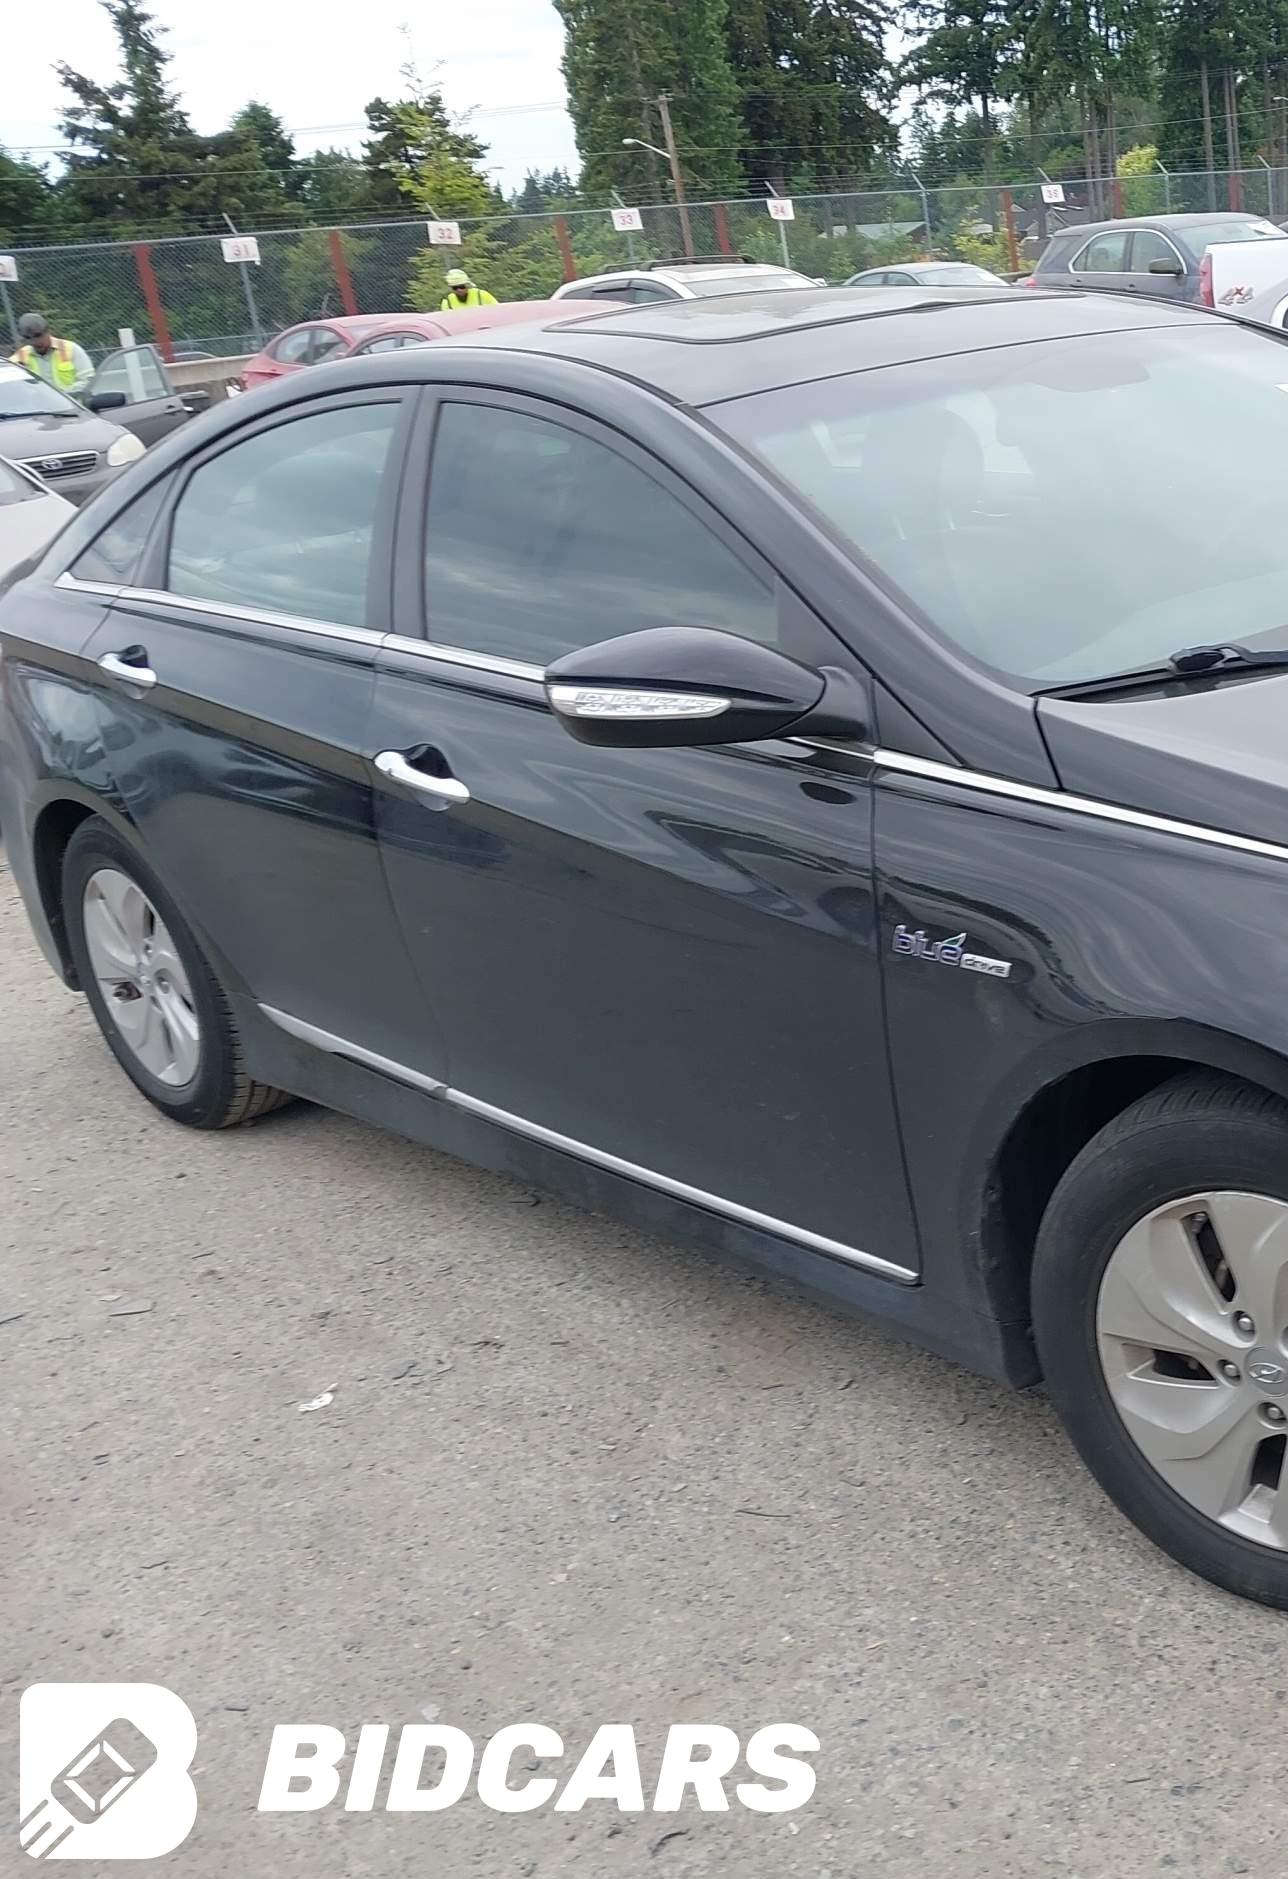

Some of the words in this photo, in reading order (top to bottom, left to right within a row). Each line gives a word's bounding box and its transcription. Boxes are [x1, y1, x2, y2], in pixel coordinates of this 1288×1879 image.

[619, 213, 633, 226] 33
[437, 227, 454, 240] 32
[232, 244, 249, 257] 31
[892, 924, 964, 966] blue
